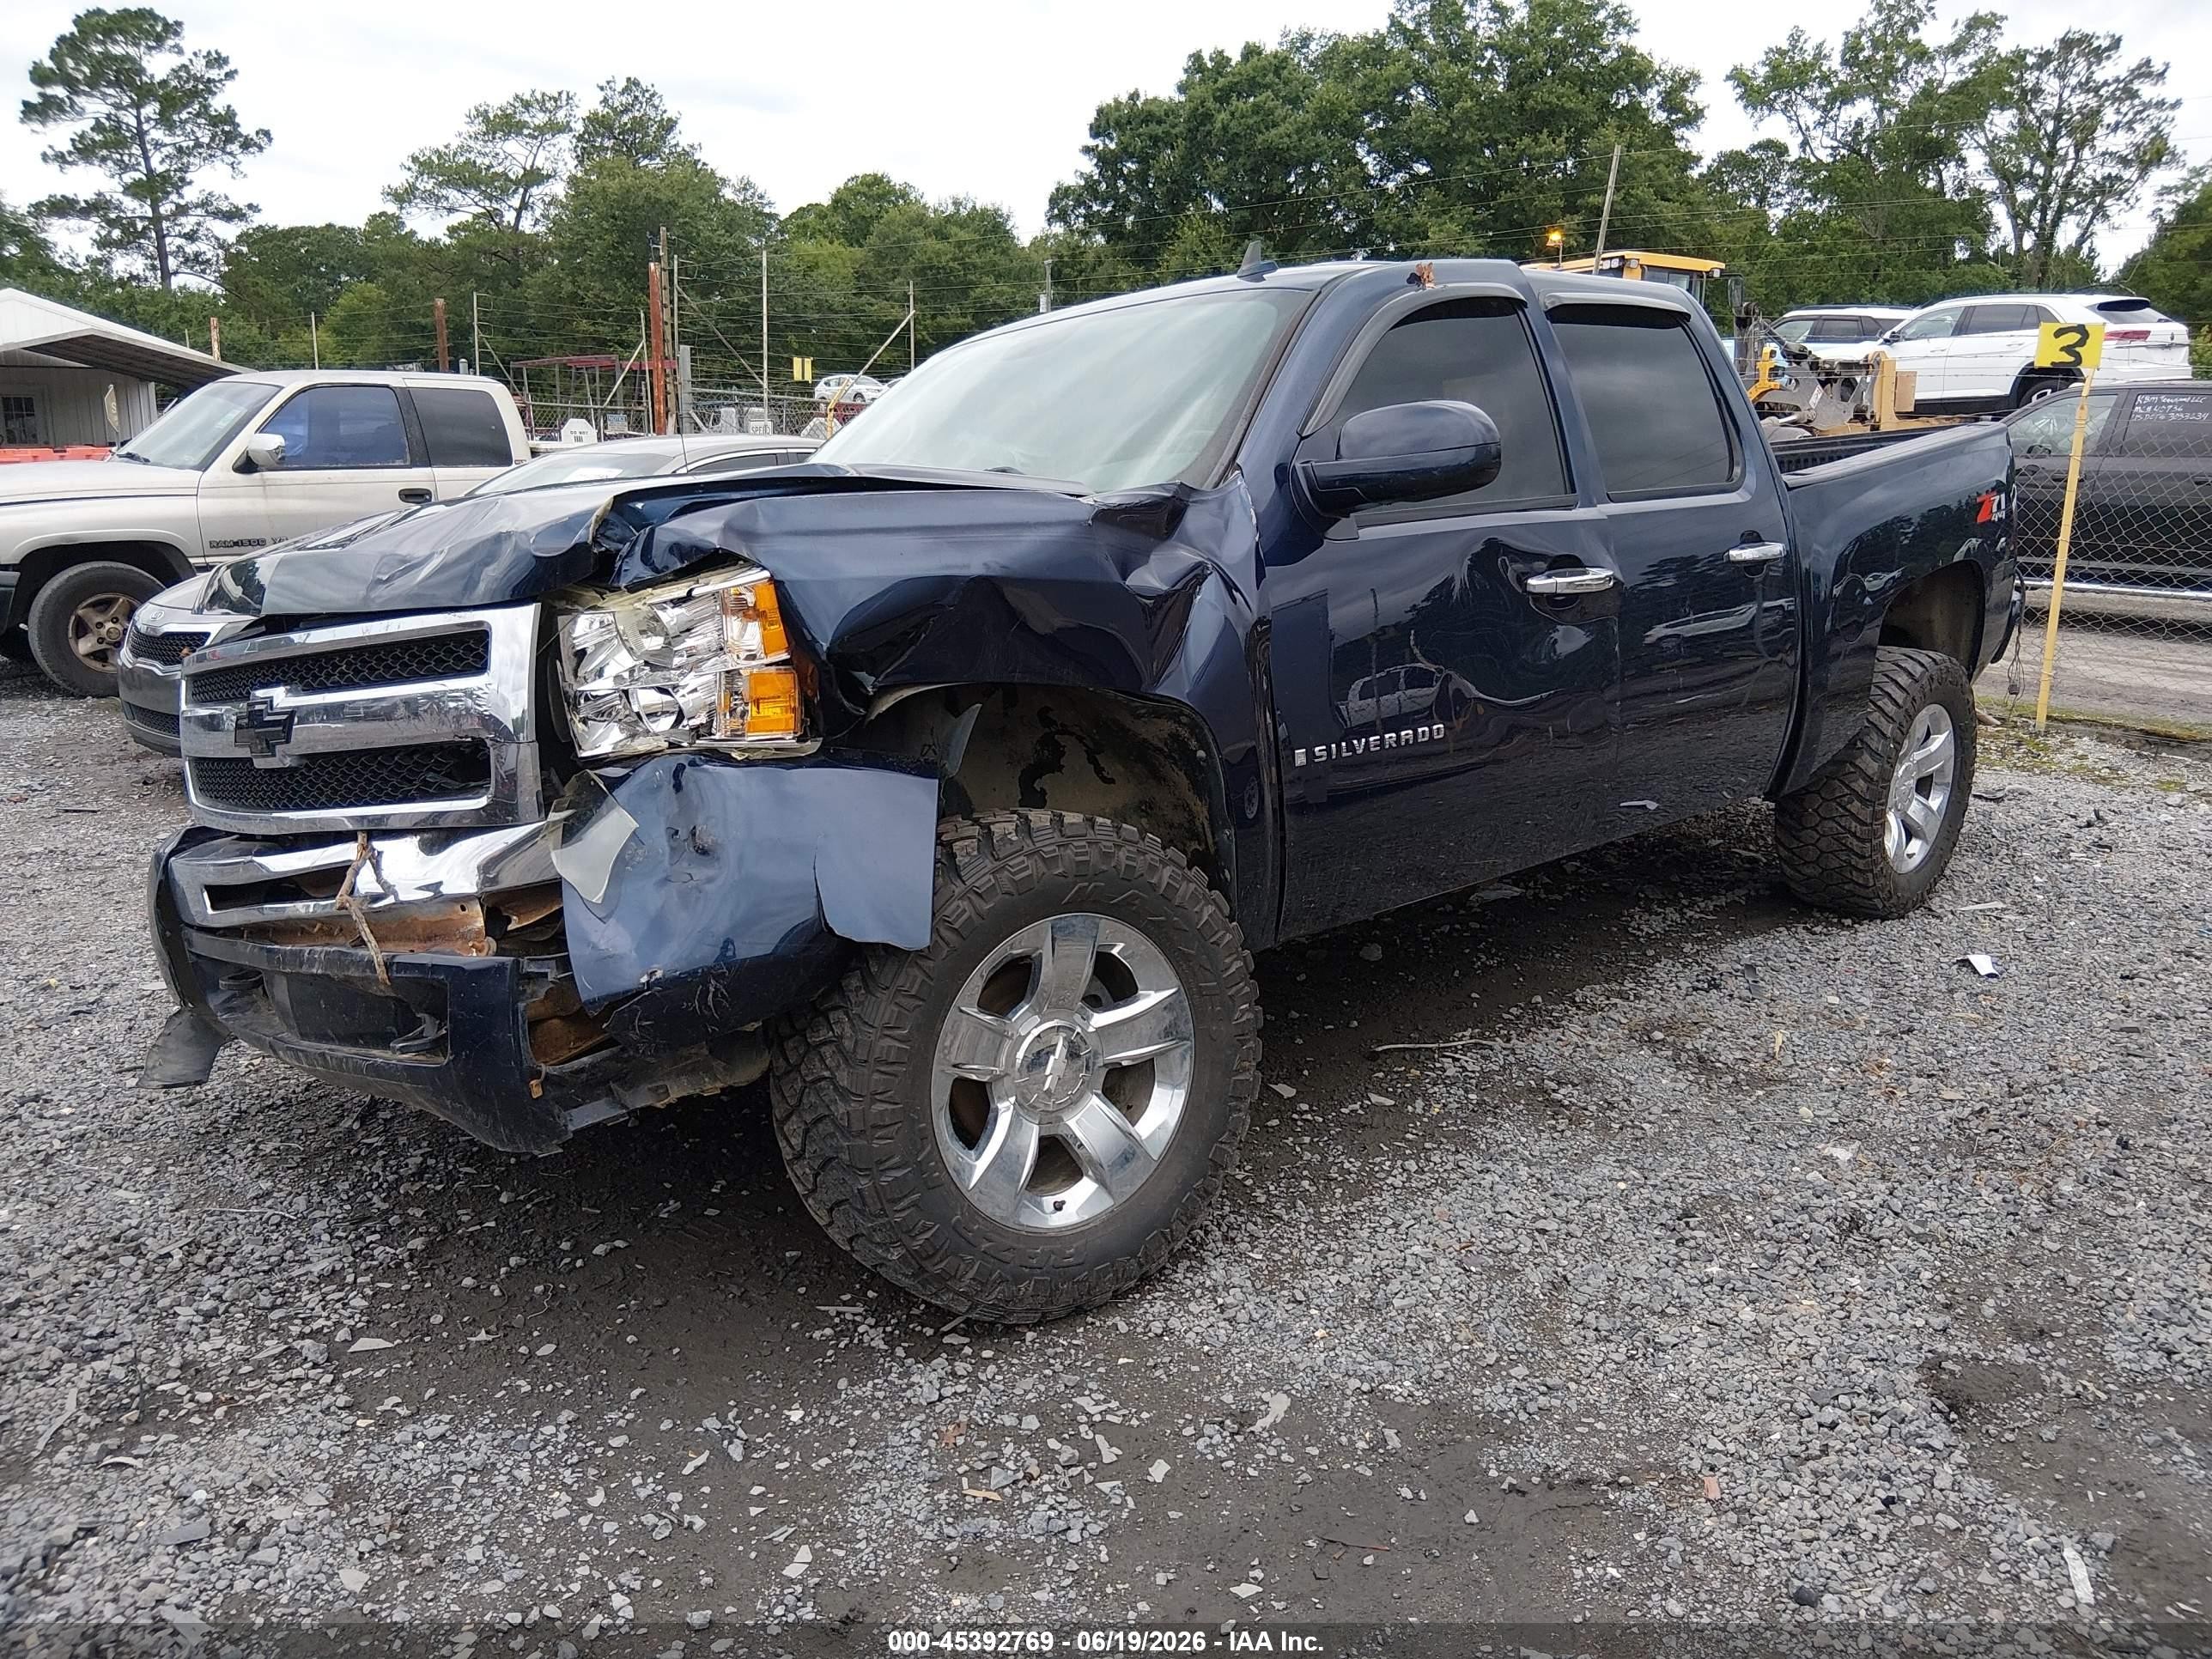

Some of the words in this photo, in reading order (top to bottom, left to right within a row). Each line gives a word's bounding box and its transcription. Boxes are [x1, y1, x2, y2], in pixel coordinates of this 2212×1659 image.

[2051, 324, 2089, 367] 3
[1977, 491, 2006, 523] Z71
[1312, 724, 1444, 763] SILVERADO
